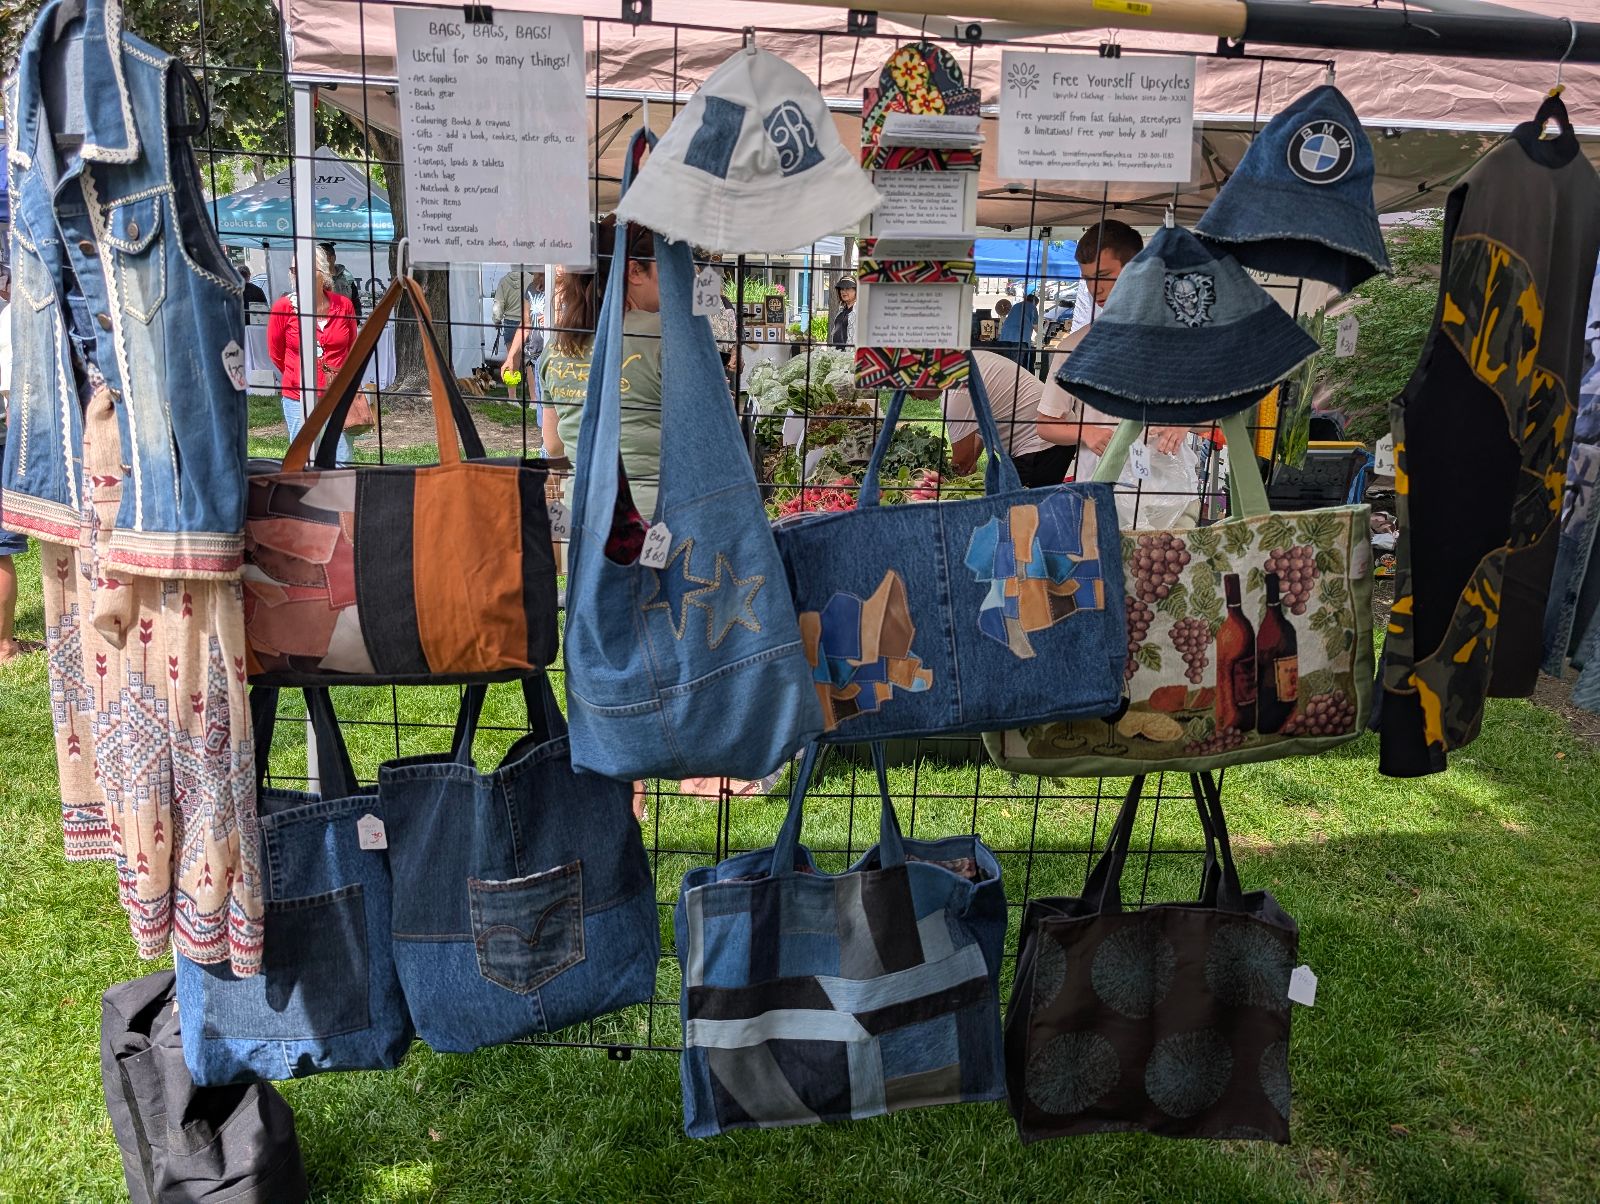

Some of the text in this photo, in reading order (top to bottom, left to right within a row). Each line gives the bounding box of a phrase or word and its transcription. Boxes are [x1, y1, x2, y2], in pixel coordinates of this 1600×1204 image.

[429, 22, 551, 41] BAGS, BAGS, BAGS!
[413, 48, 571, 70] Useful for so many things!
[1053, 72, 1190, 92] Free Yourself Upcycles
[414, 89, 455, 99] Beach gear
[416, 117, 447, 126] Colouring
[485, 120, 510, 128] crayons
[1016, 111, 1181, 125] Free yourself from fast fashion, stereotypes
[417, 130, 432, 138] Gifts
[522, 134, 539, 142] other
[1034, 126, 1073, 135] limitations!
[1077, 128, 1094, 136] Free
[1099, 130, 1114, 138] your
[1119, 128, 1135, 139] body
[1151, 129, 1167, 138] soul!
[1300, 123, 1351, 149] BMW
[418, 144, 433, 152] Gym
[419, 171, 455, 181] Lunch bag
[421, 184, 449, 192] Notebook
[464, 185, 499, 194] pen/pencil
[423, 224, 478, 233] Travel essentials
[424, 237, 440, 245] Work
[540, 239, 547, 248] of
